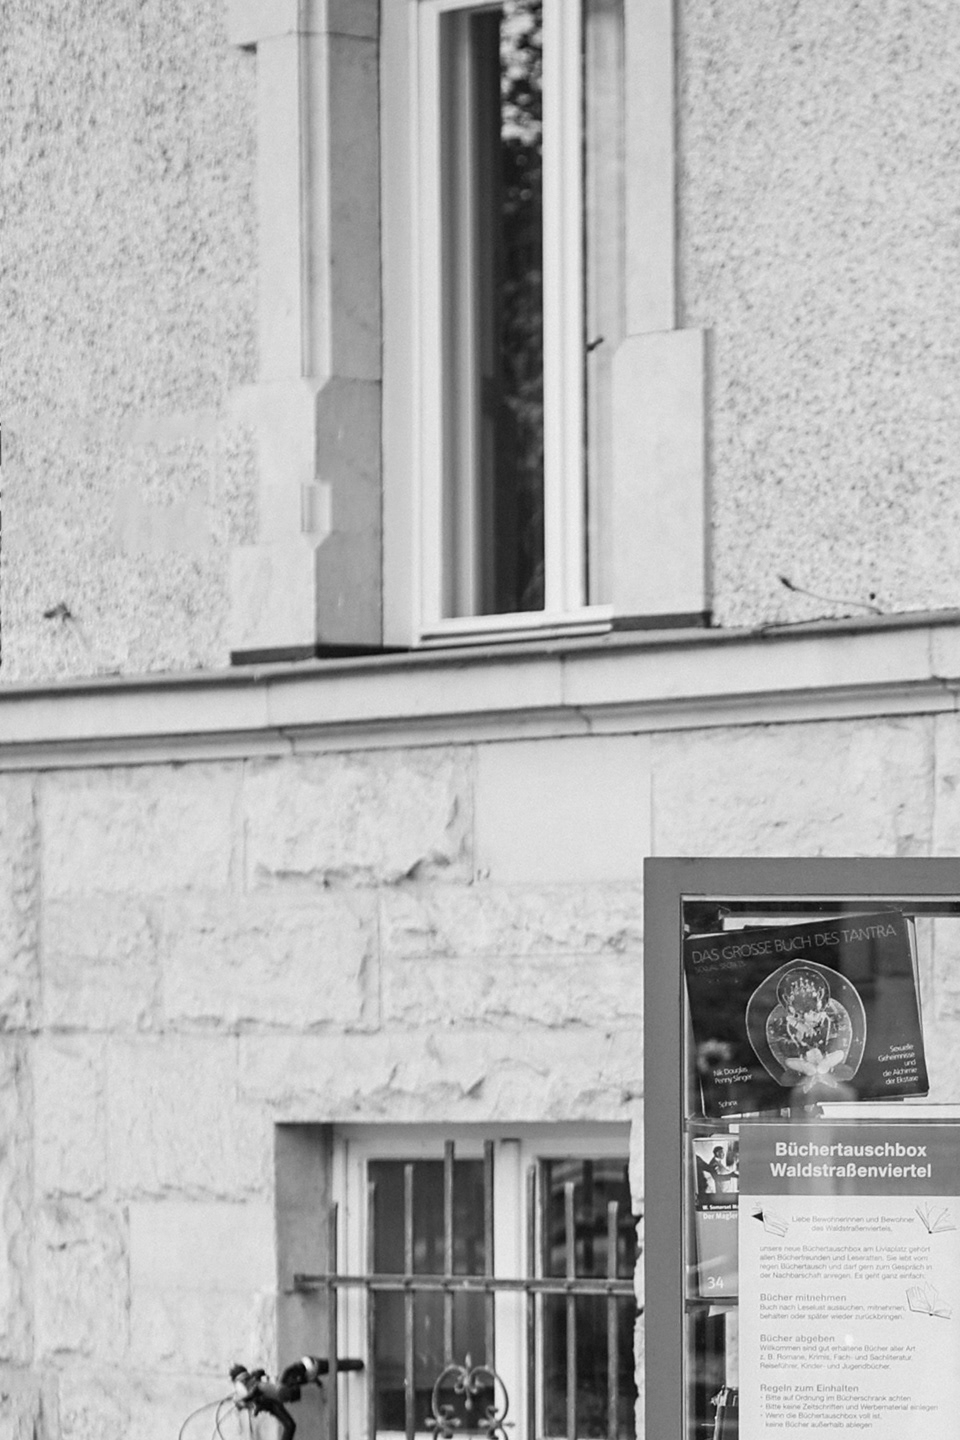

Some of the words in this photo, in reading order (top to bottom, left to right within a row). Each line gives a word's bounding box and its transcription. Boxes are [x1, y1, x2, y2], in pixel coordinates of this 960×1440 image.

[692, 948, 719, 964] DAS
[722, 940, 773, 960] GROSSE
[774, 936, 812, 952] BUCH
[815, 931, 840, 947] DES
[841, 924, 896, 942] TANTRA
[878, 1052, 915, 1062] Geheimnisse
[724, 1066, 748, 1075] Douglas
[733, 1074, 752, 1082] Slinger
[775, 1141, 927, 1157] Büchertauschbox
[770, 1163, 932, 1178] Waldstraßenviertel
[876, 1246, 906, 1254] Liviaplatz
[909, 1246, 930, 1254] gehört
[892, 1264, 924, 1272] Gespräch
[865, 1273, 879, 1281] geht
[707, 1276, 724, 1289] 34
[827, 1304, 865, 1312] aussuchen,
[867, 1304, 906, 1312] mitnehmen,
[808, 1313, 829, 1321] später
[855, 1313, 904, 1321] zurückbringen.
[795, 1335, 835, 1344] abgeben
[819, 1345, 829, 1353] gut
[760, 1384, 792, 1394] Regeln
[817, 1384, 858, 1392] Einhalten
[795, 1395, 824, 1403] Ordnung
[910, 1404, 938, 1412] einlegen
[846, 1421, 872, 1429] ablegen
